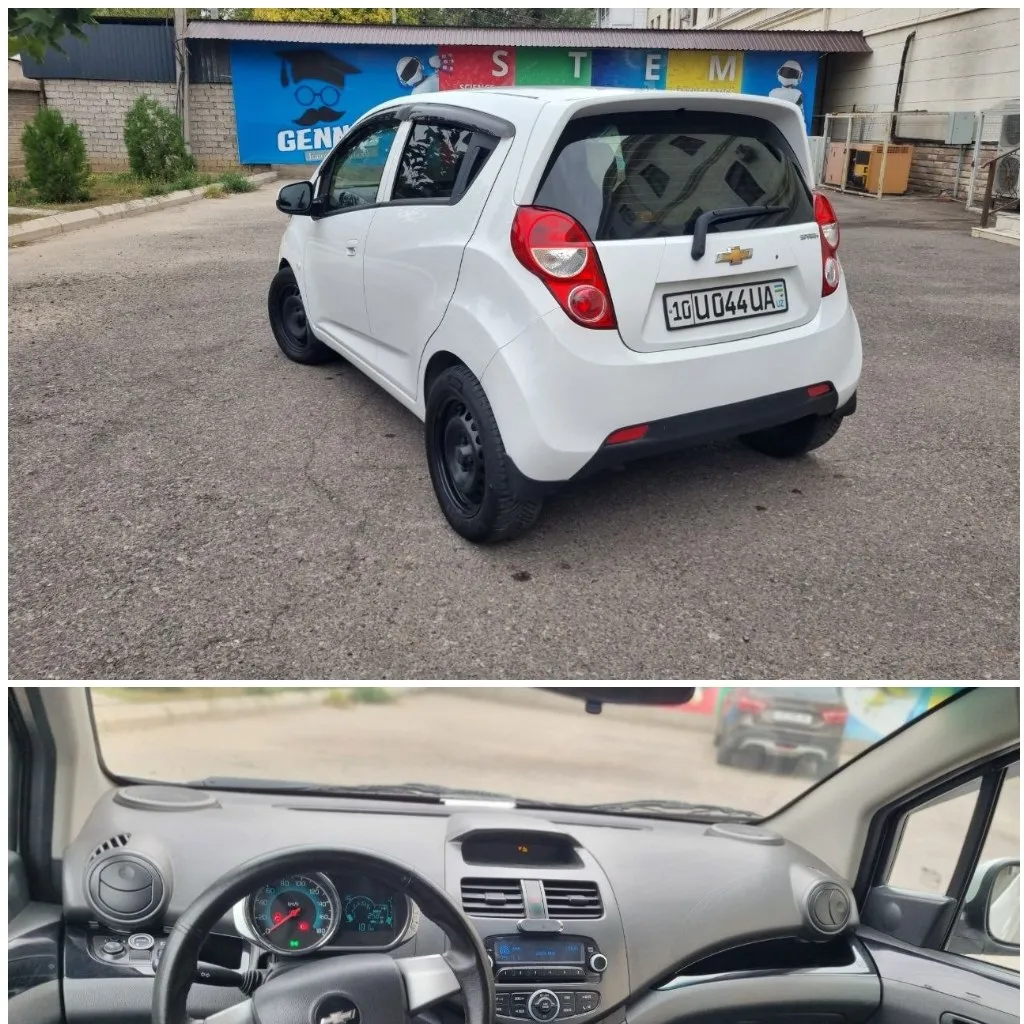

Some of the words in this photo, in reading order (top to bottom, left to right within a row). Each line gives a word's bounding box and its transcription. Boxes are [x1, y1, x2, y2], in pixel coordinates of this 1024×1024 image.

[492, 50, 509, 77] S
[568, 51, 588, 78] T
[645, 54, 662, 81] E
[709, 55, 737, 82] M
[672, 300, 692, 322] 10
